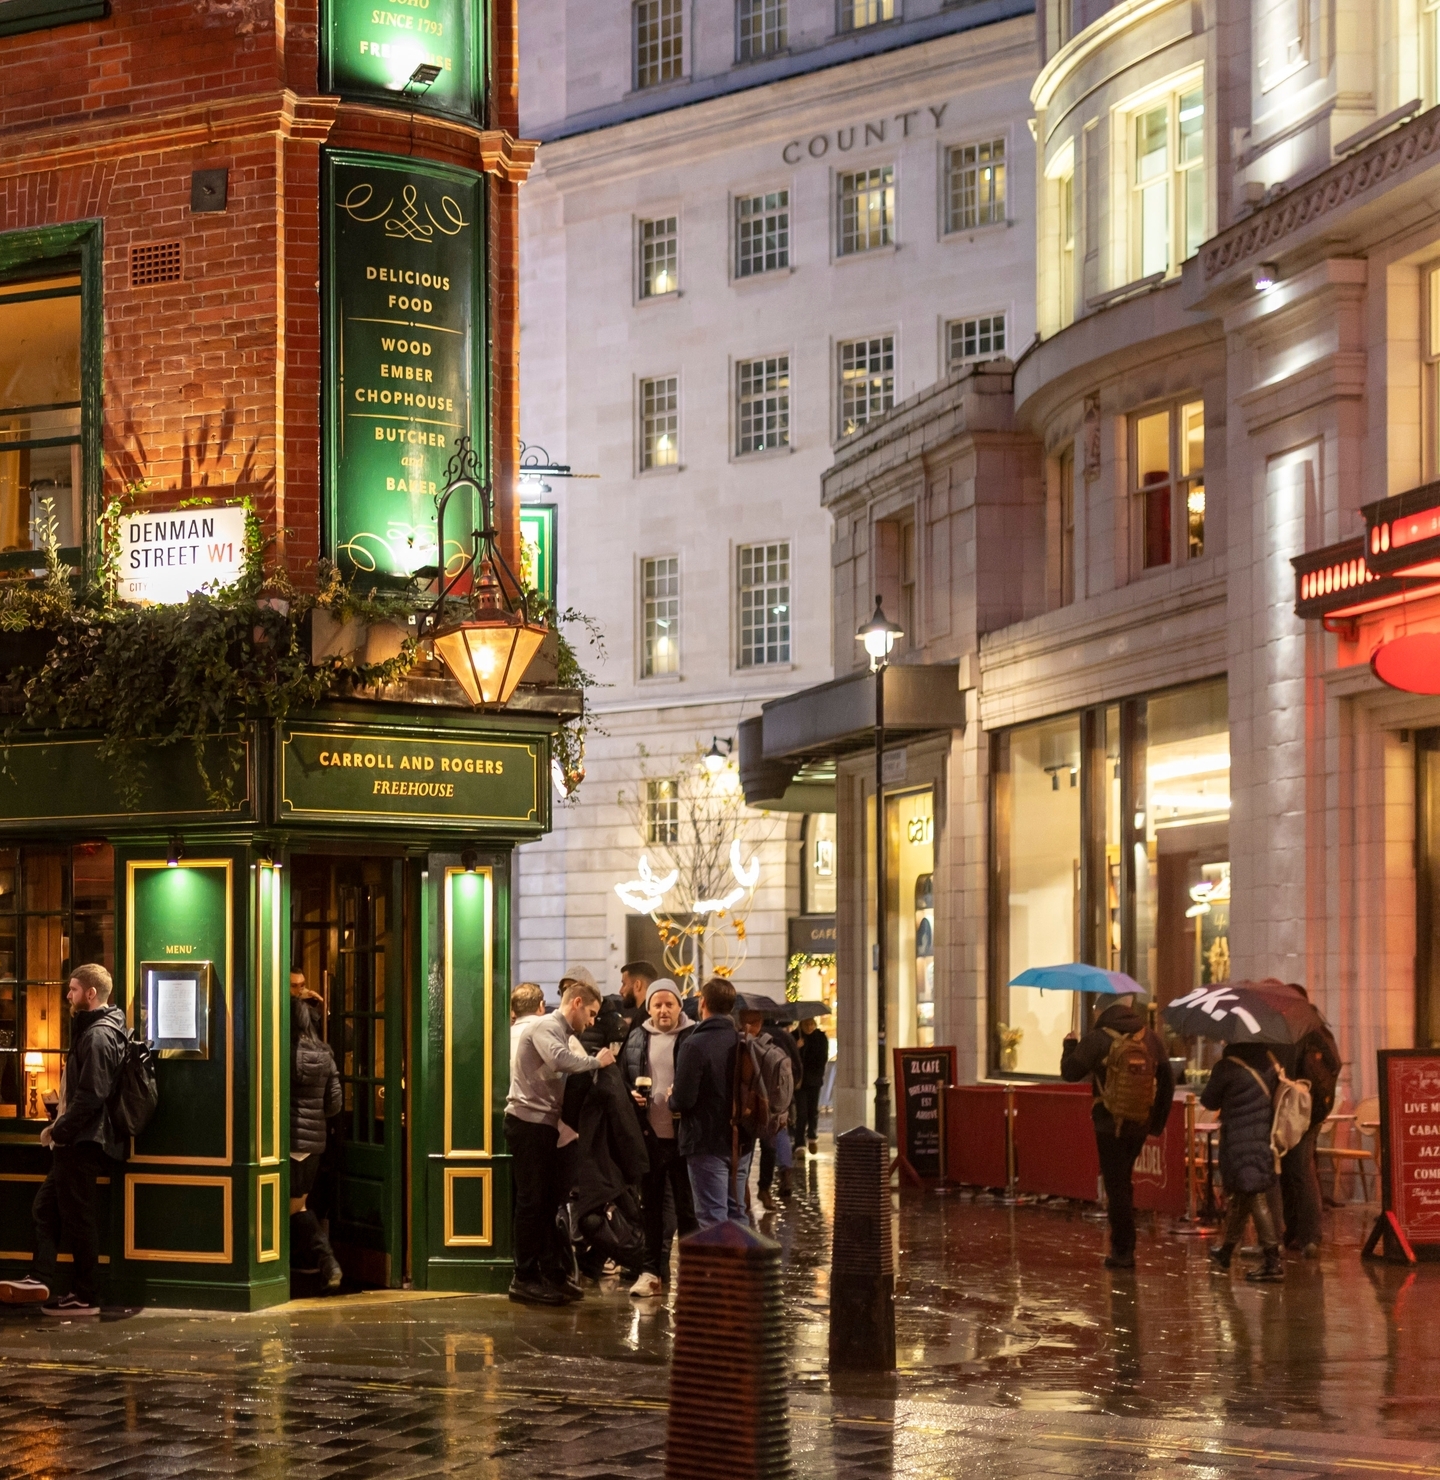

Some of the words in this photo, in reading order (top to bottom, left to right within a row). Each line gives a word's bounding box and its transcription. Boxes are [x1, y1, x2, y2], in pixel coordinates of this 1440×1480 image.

[371, 10, 413, 29] SINCE
[417, 18, 443, 36] 1793
[360, 41, 452, 71] FREUSE
[782, 102, 948, 165] COUNTY
[366, 266, 450, 291] DELICIOUS
[388, 295, 433, 313] FOOD
[381, 337, 432, 356] WOOD
[380, 364, 433, 383] EMBER
[355, 388, 453, 412] CHOPHOUSE
[375, 427, 446, 448] BUTCHER
[401, 455, 424, 467] and
[386, 477, 437, 495] BAKER
[130, 518, 214, 543] DENMAN
[130, 545, 199, 569] STREET
[207, 543, 233, 563] W1
[320, 751, 394, 769] CARROLL
[400, 756, 434, 770] AND
[441, 757, 503, 775] ROGERS
[372, 780, 454, 797] FREEHOUSE
[166, 945, 192, 954] MENU
[1404, 1103, 1428, 1113] LIVE
[1409, 1125, 1440, 1136] CABA
